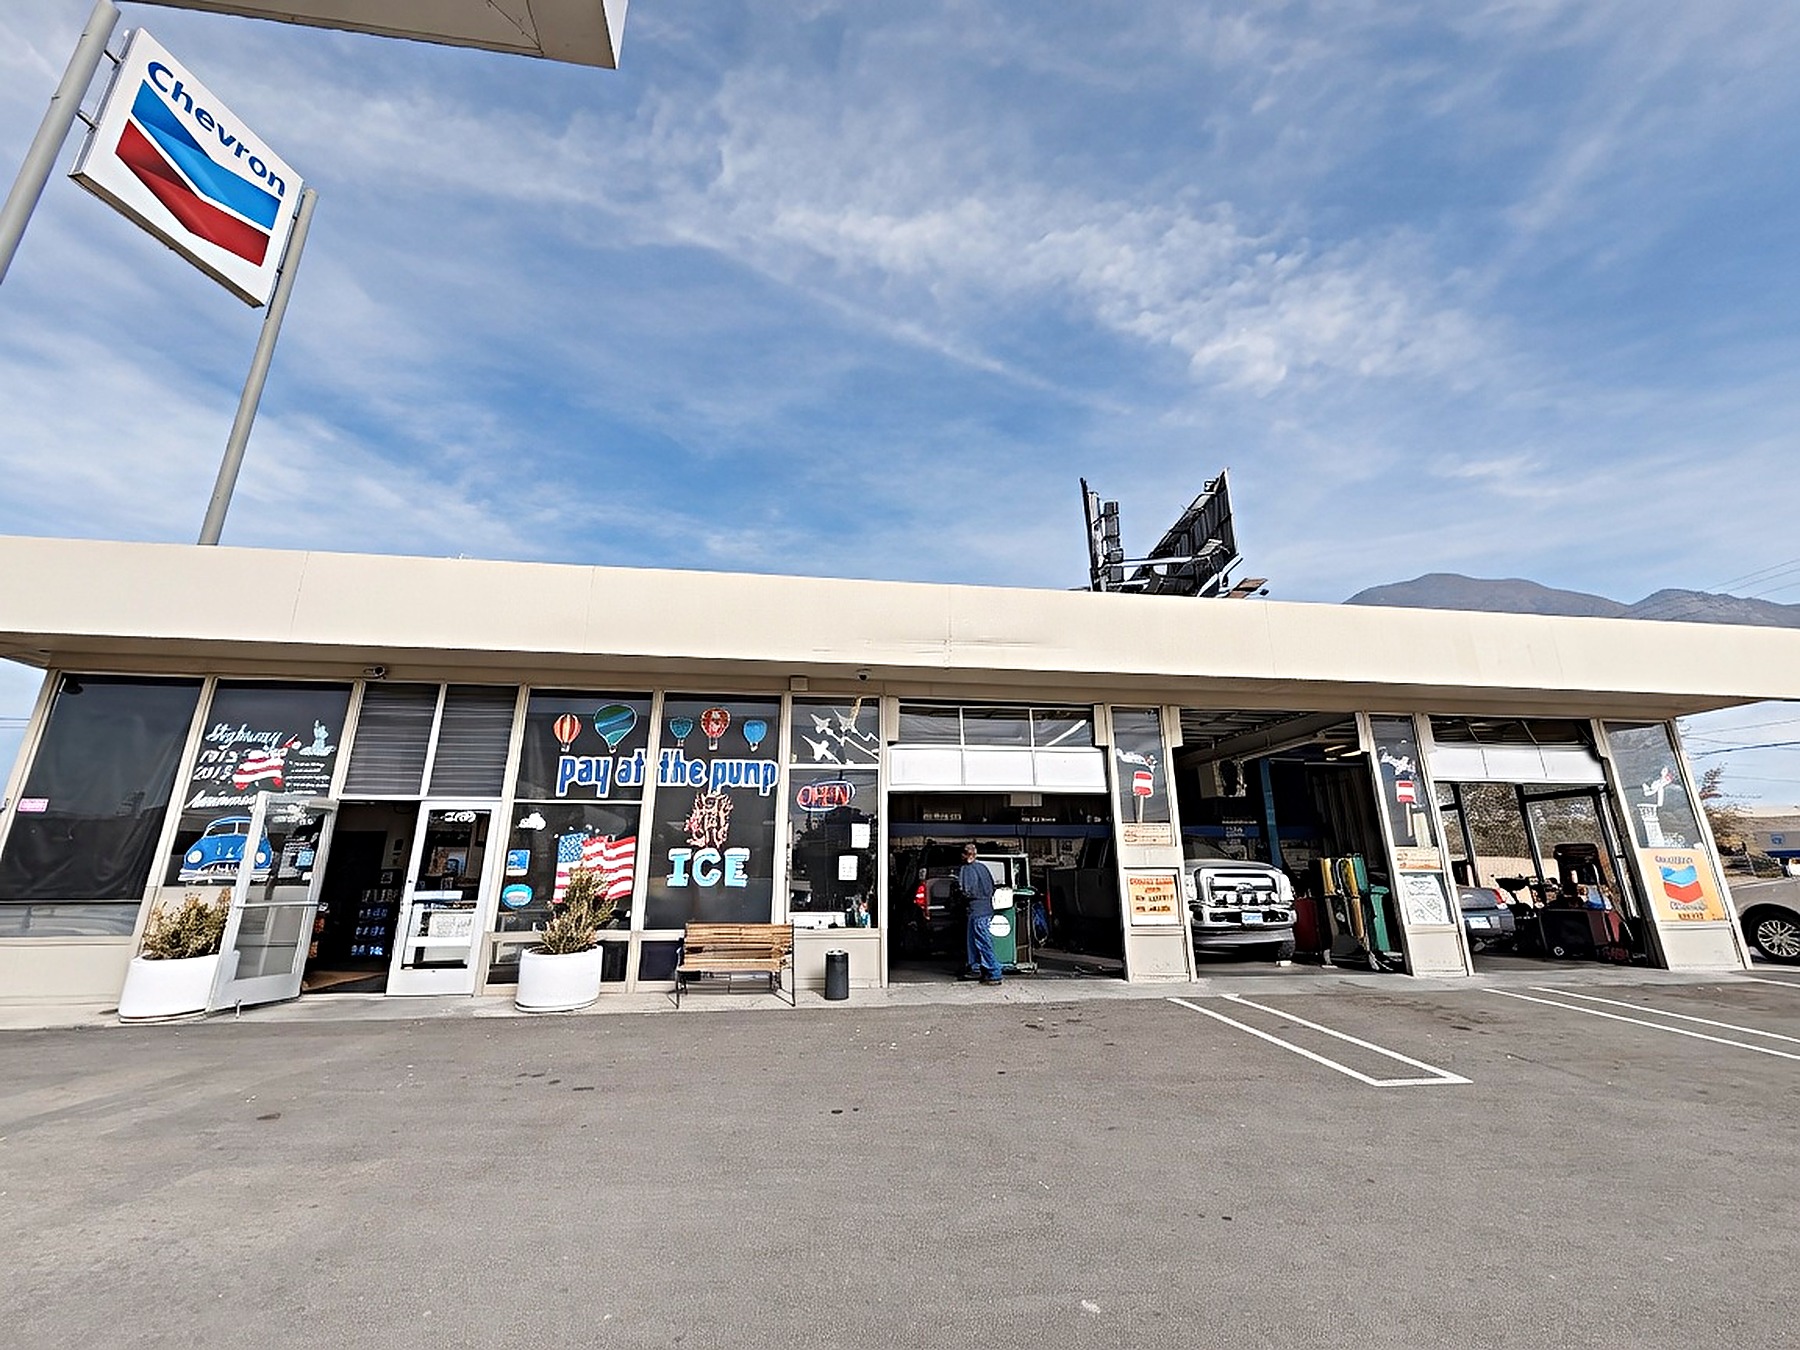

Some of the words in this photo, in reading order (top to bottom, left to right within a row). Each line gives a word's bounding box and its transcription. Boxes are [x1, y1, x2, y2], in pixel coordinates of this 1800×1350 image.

[148, 61, 286, 197] Chevron
[556, 756, 613, 797] pay
[615, 748, 647, 786] at
[658, 748, 707, 787] the
[797, 784, 850, 806] OPEN
[666, 847, 751, 887] ICE
